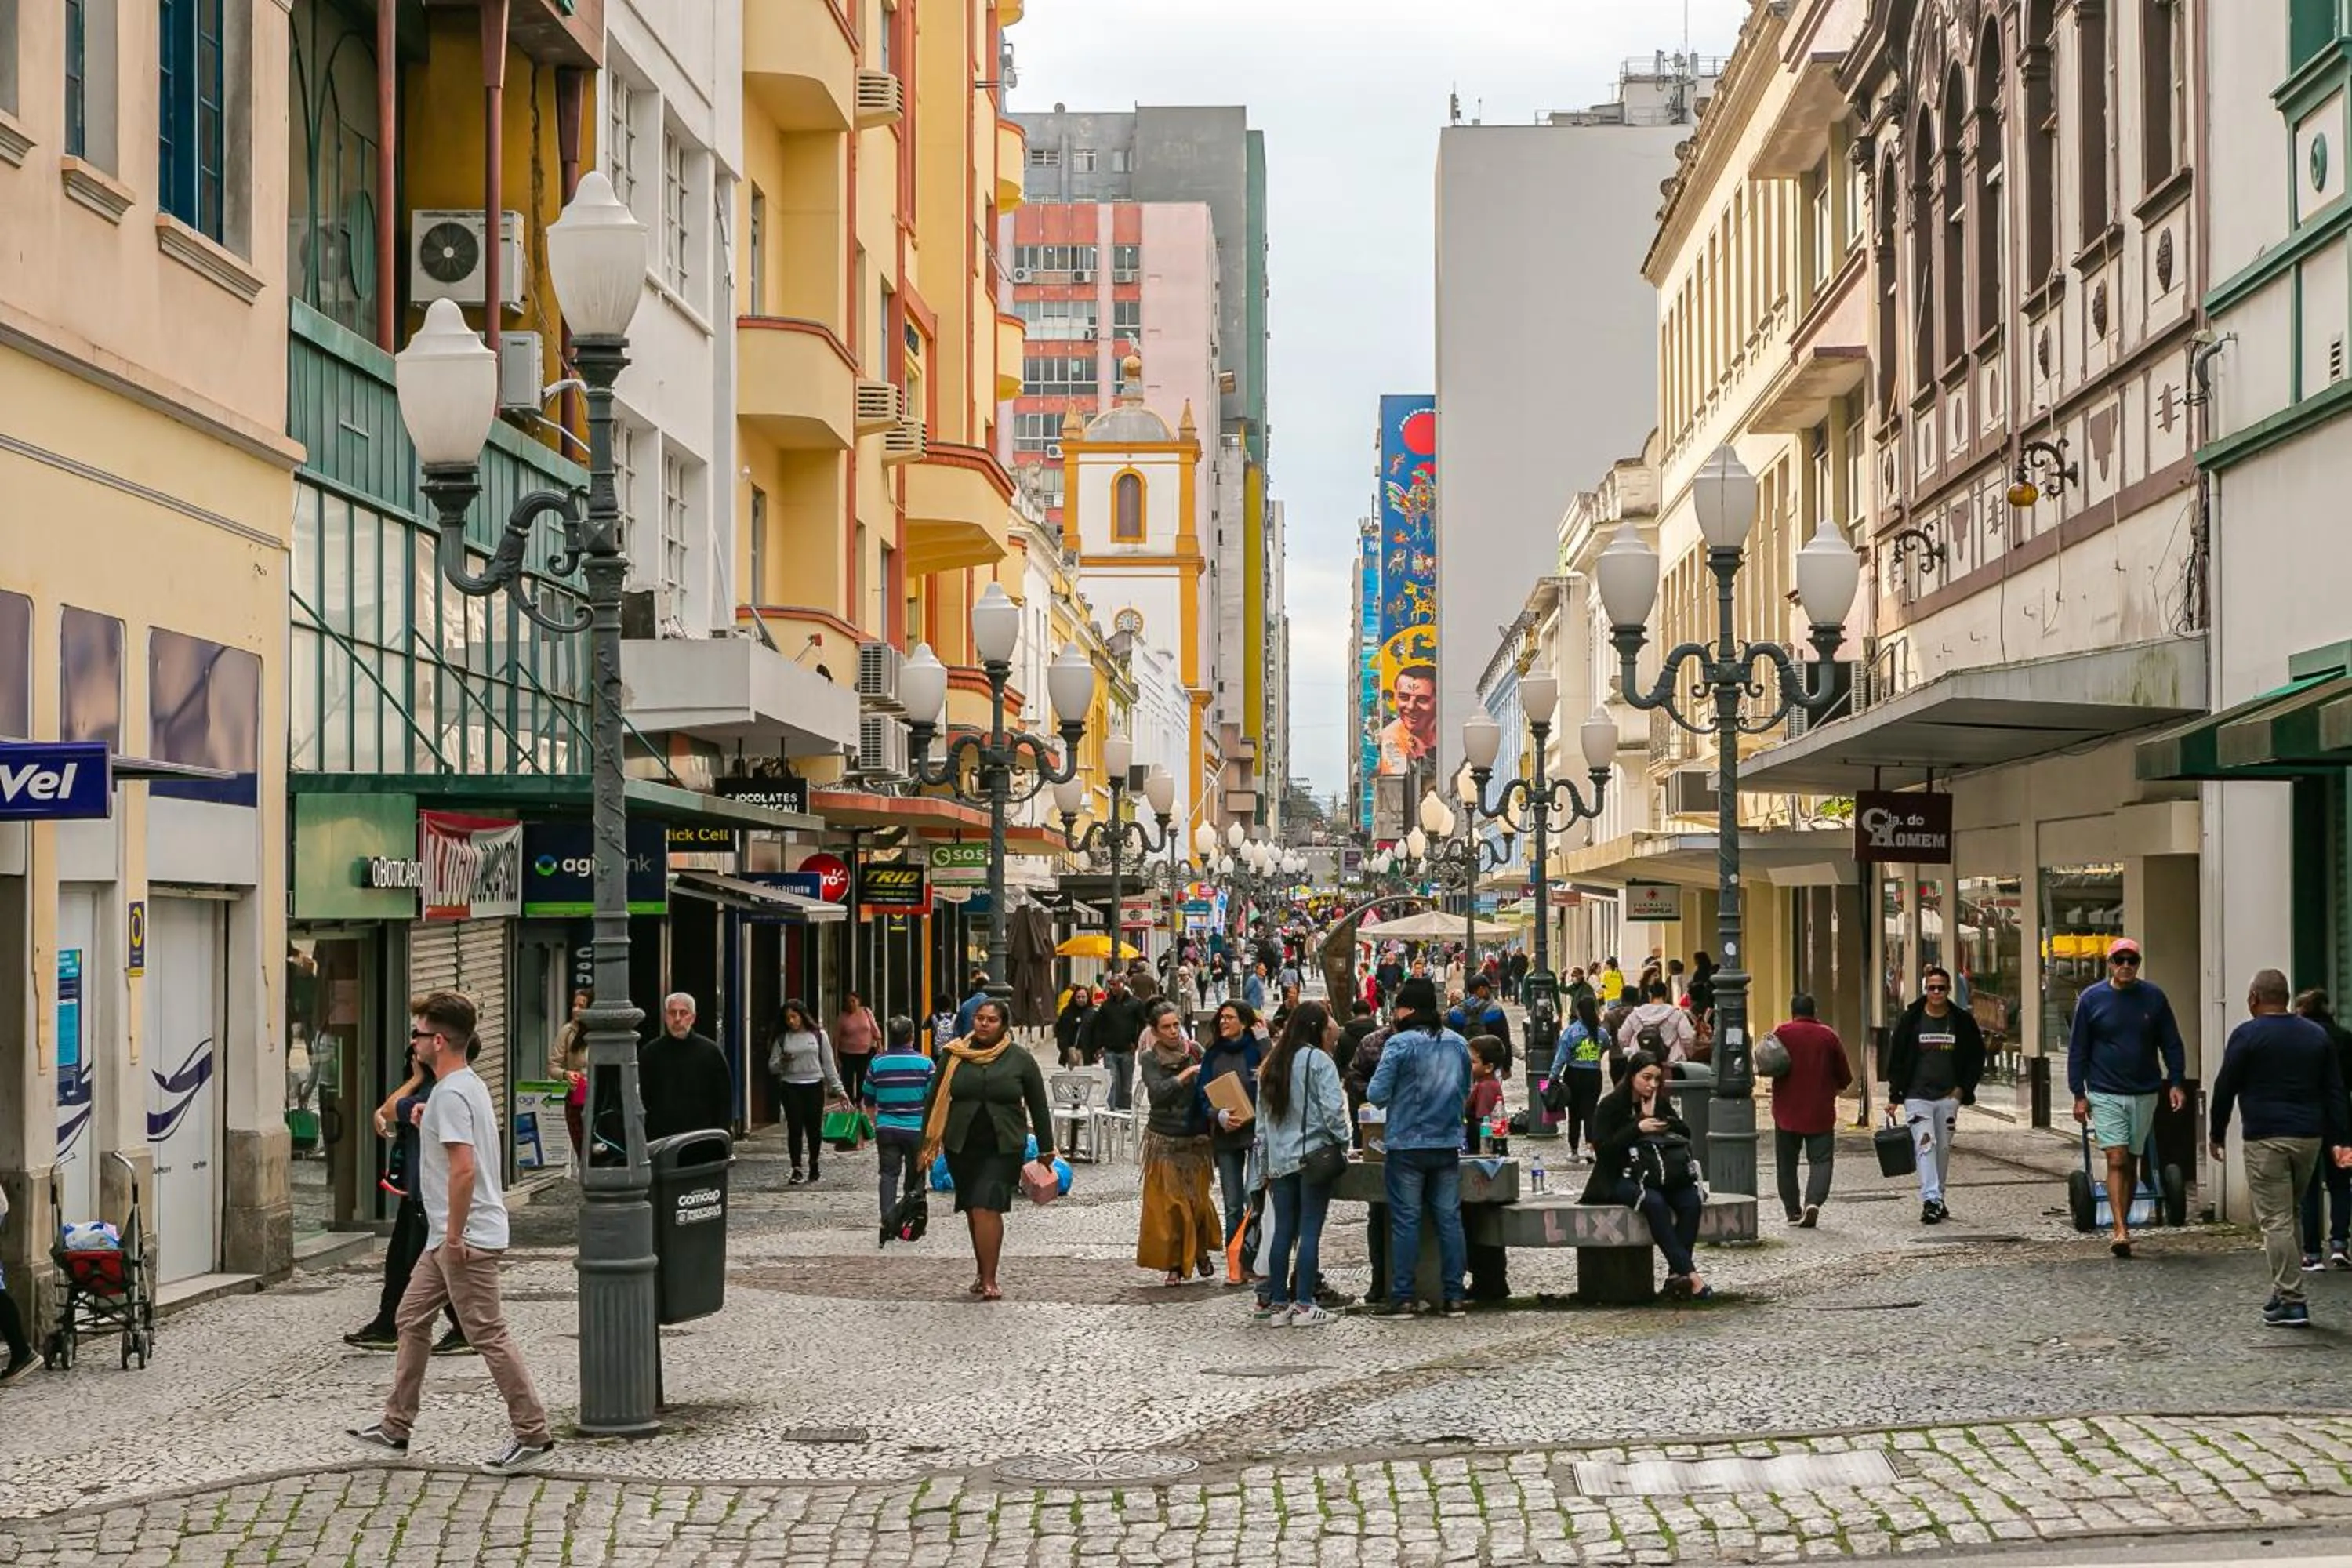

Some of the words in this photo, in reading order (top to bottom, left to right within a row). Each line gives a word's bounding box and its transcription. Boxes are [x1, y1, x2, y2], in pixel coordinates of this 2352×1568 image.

[761, 804, 797, 814] ACAU
[1907, 814, 1925, 826] do
[699, 828, 729, 841] Cell
[1868, 823, 1946, 848] HOMEM
[562, 852, 652, 877] agink
